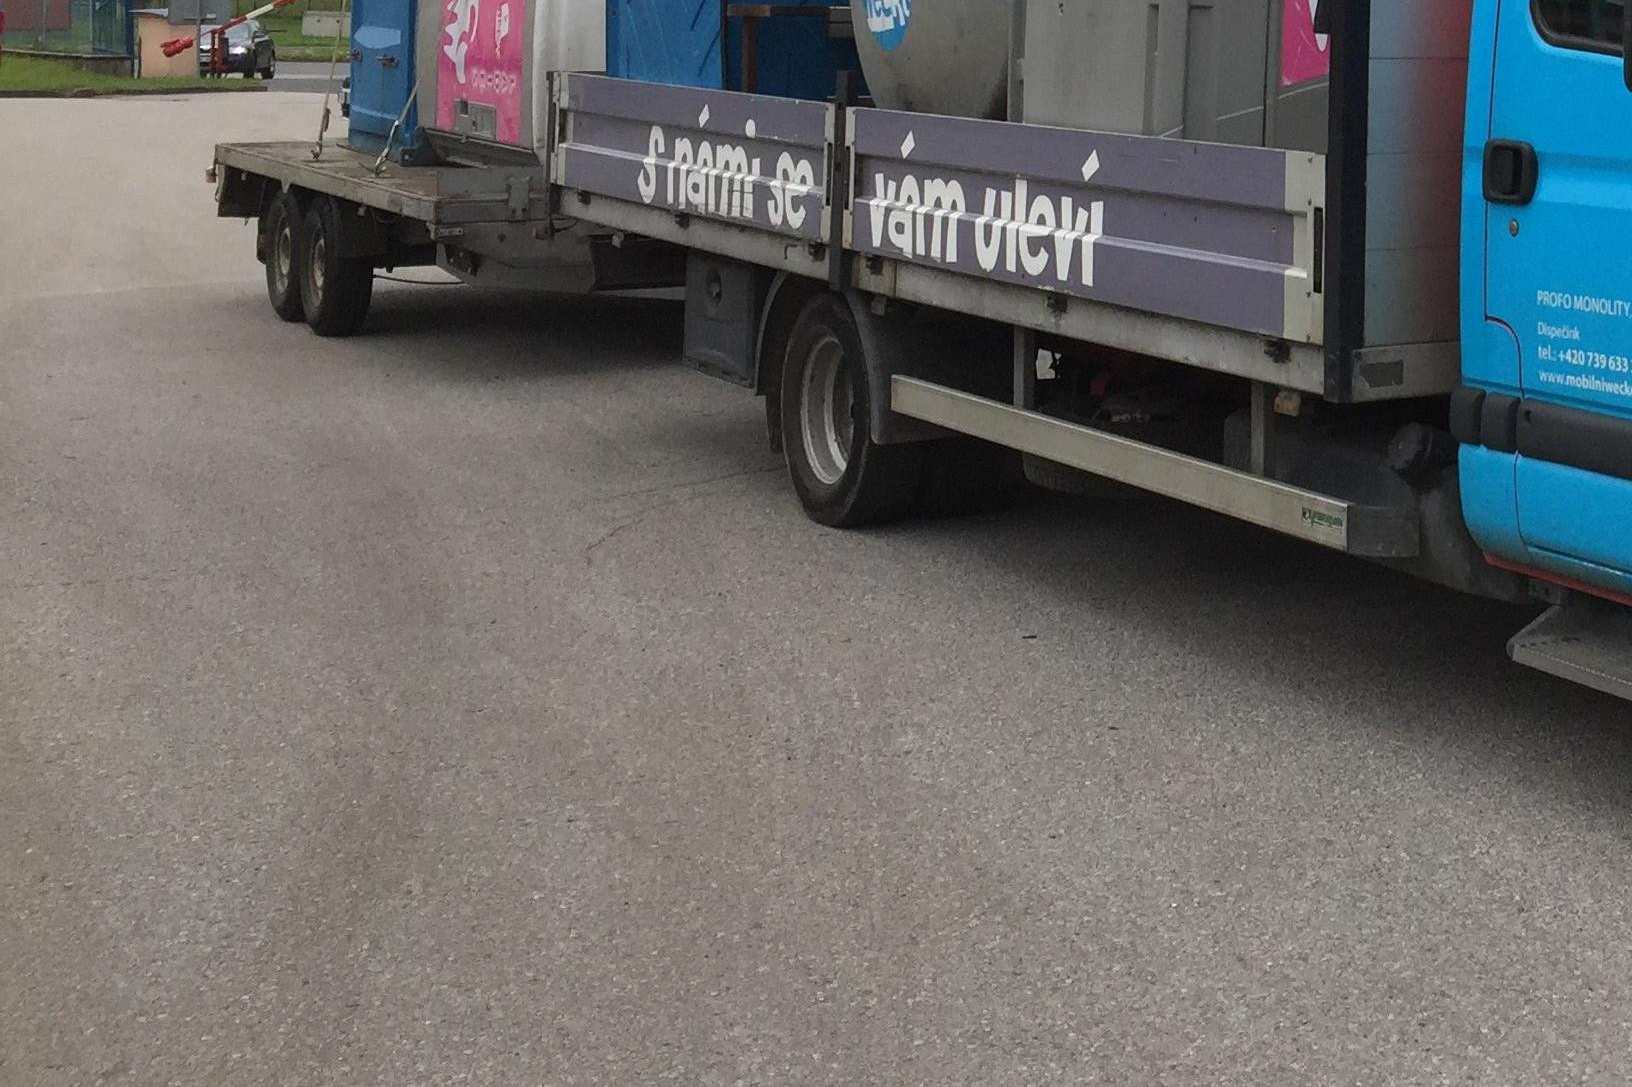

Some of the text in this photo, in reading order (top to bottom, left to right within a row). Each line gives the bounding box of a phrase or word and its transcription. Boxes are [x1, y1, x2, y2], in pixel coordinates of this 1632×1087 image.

[667, 103, 761, 219] námi
[767, 151, 815, 230] se
[869, 130, 966, 264] vám
[974, 148, 1105, 288] uleví
[1536, 289, 1572, 310] PROFO
[1573, 295, 1632, 319] MONOLITY,
[1558, 348, 1585, 366] +420
[1587, 352, 1607, 369] 739
[1608, 355, 1629, 373] 633
